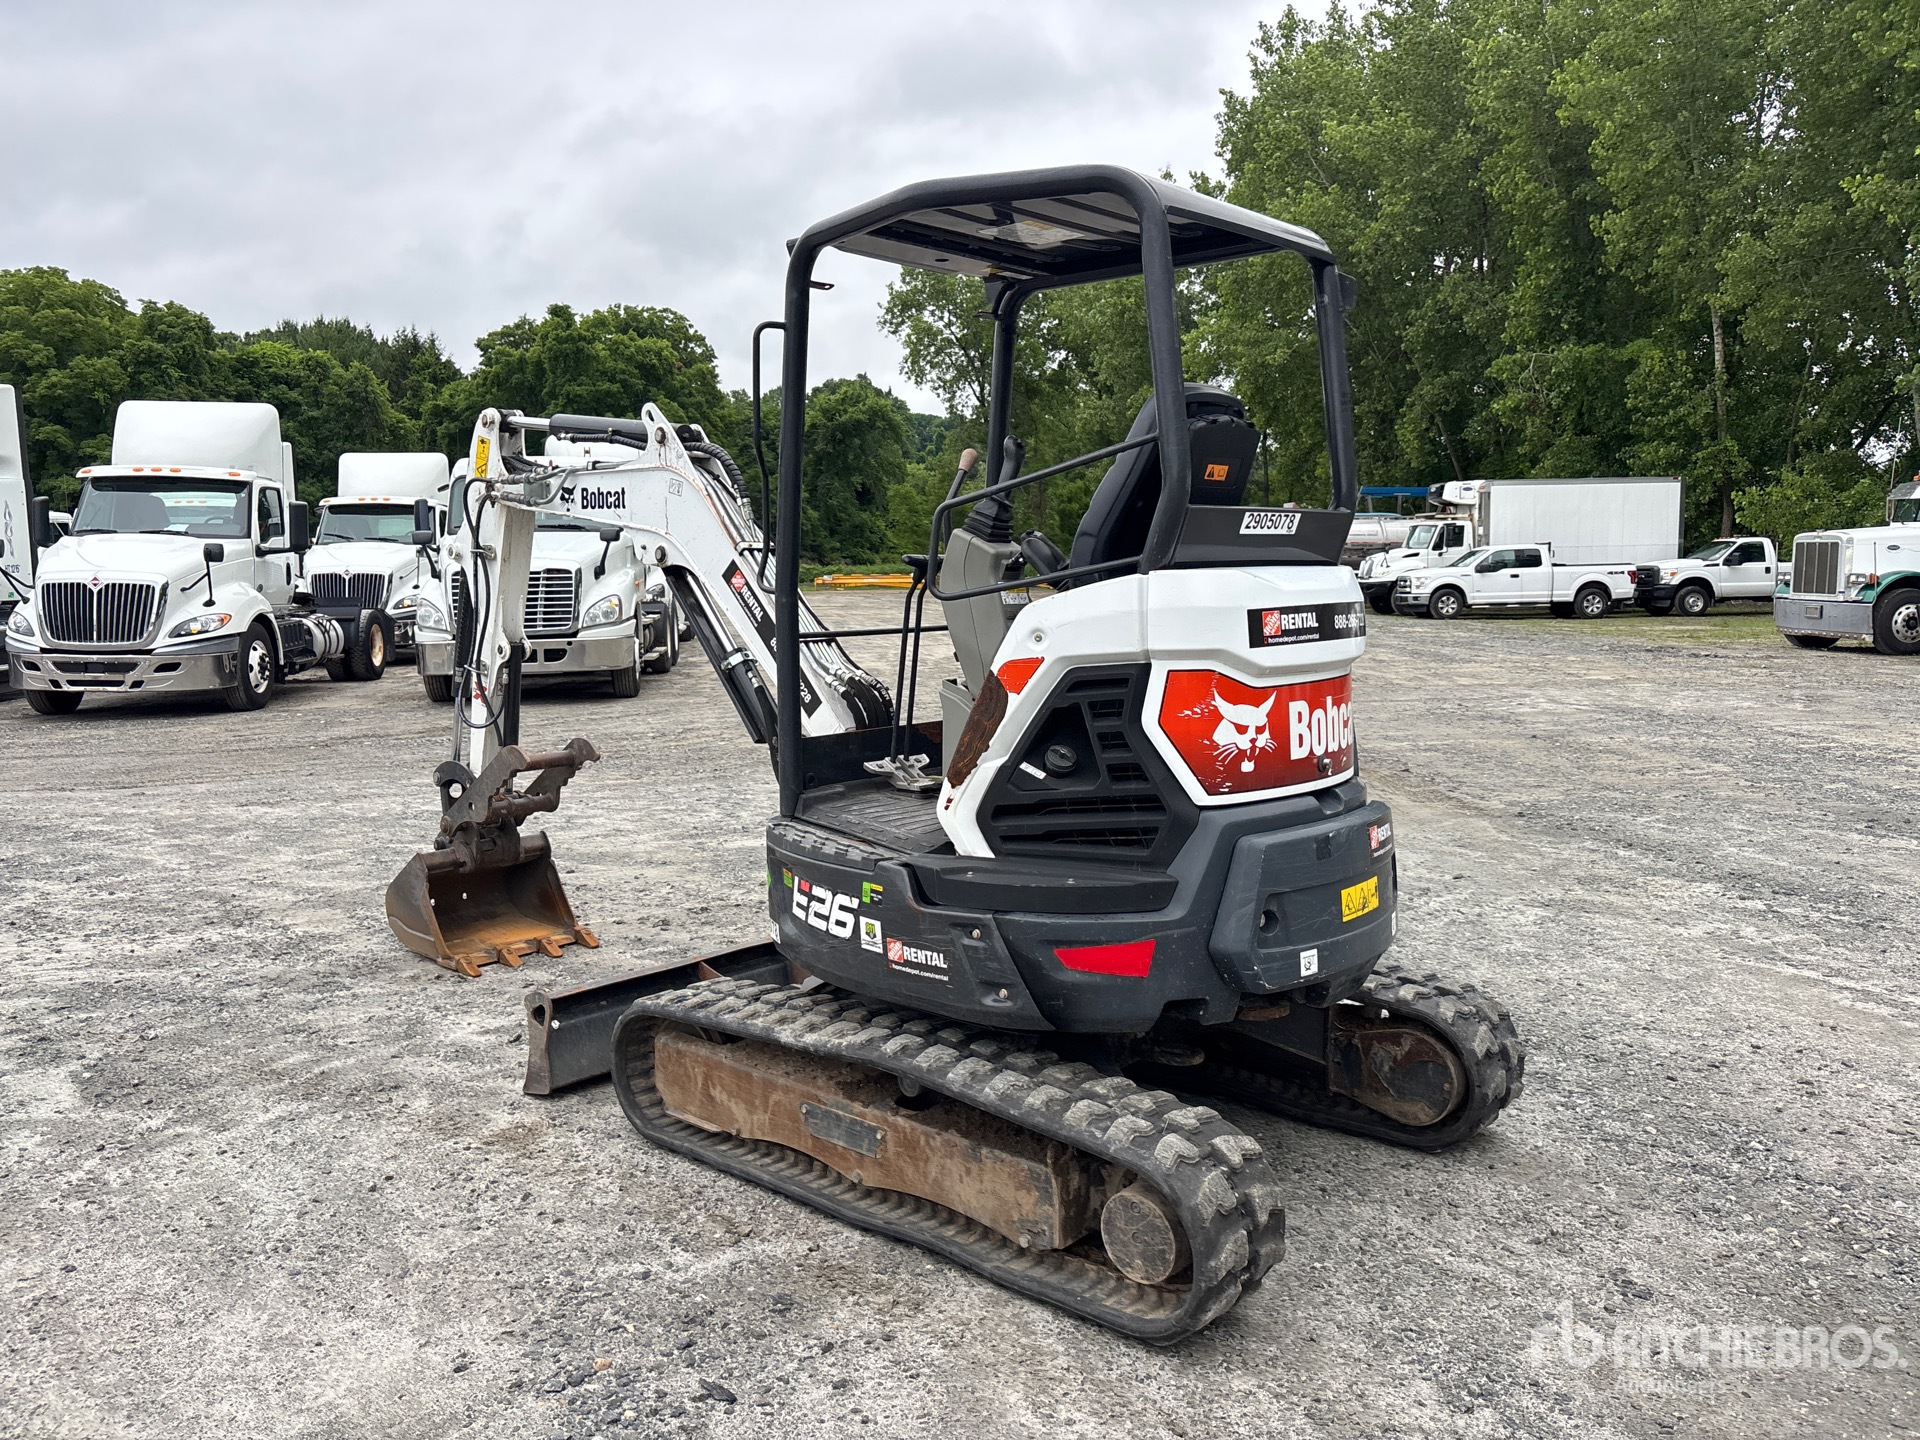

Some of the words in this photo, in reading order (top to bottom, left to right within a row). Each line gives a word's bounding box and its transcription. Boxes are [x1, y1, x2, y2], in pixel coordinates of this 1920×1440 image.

[581, 487, 626, 510] Bobcat
[1244, 513, 1296, 530] 2905078
[740, 585, 764, 622] RENTAL
[1281, 612, 1319, 630] RENTAL
[1268, 633, 1319, 643] homedepot.com/rental
[792, 876, 860, 939] E26
[903, 946, 948, 968] RENTAL
[892, 963, 948, 981] homedepot.com/rental
